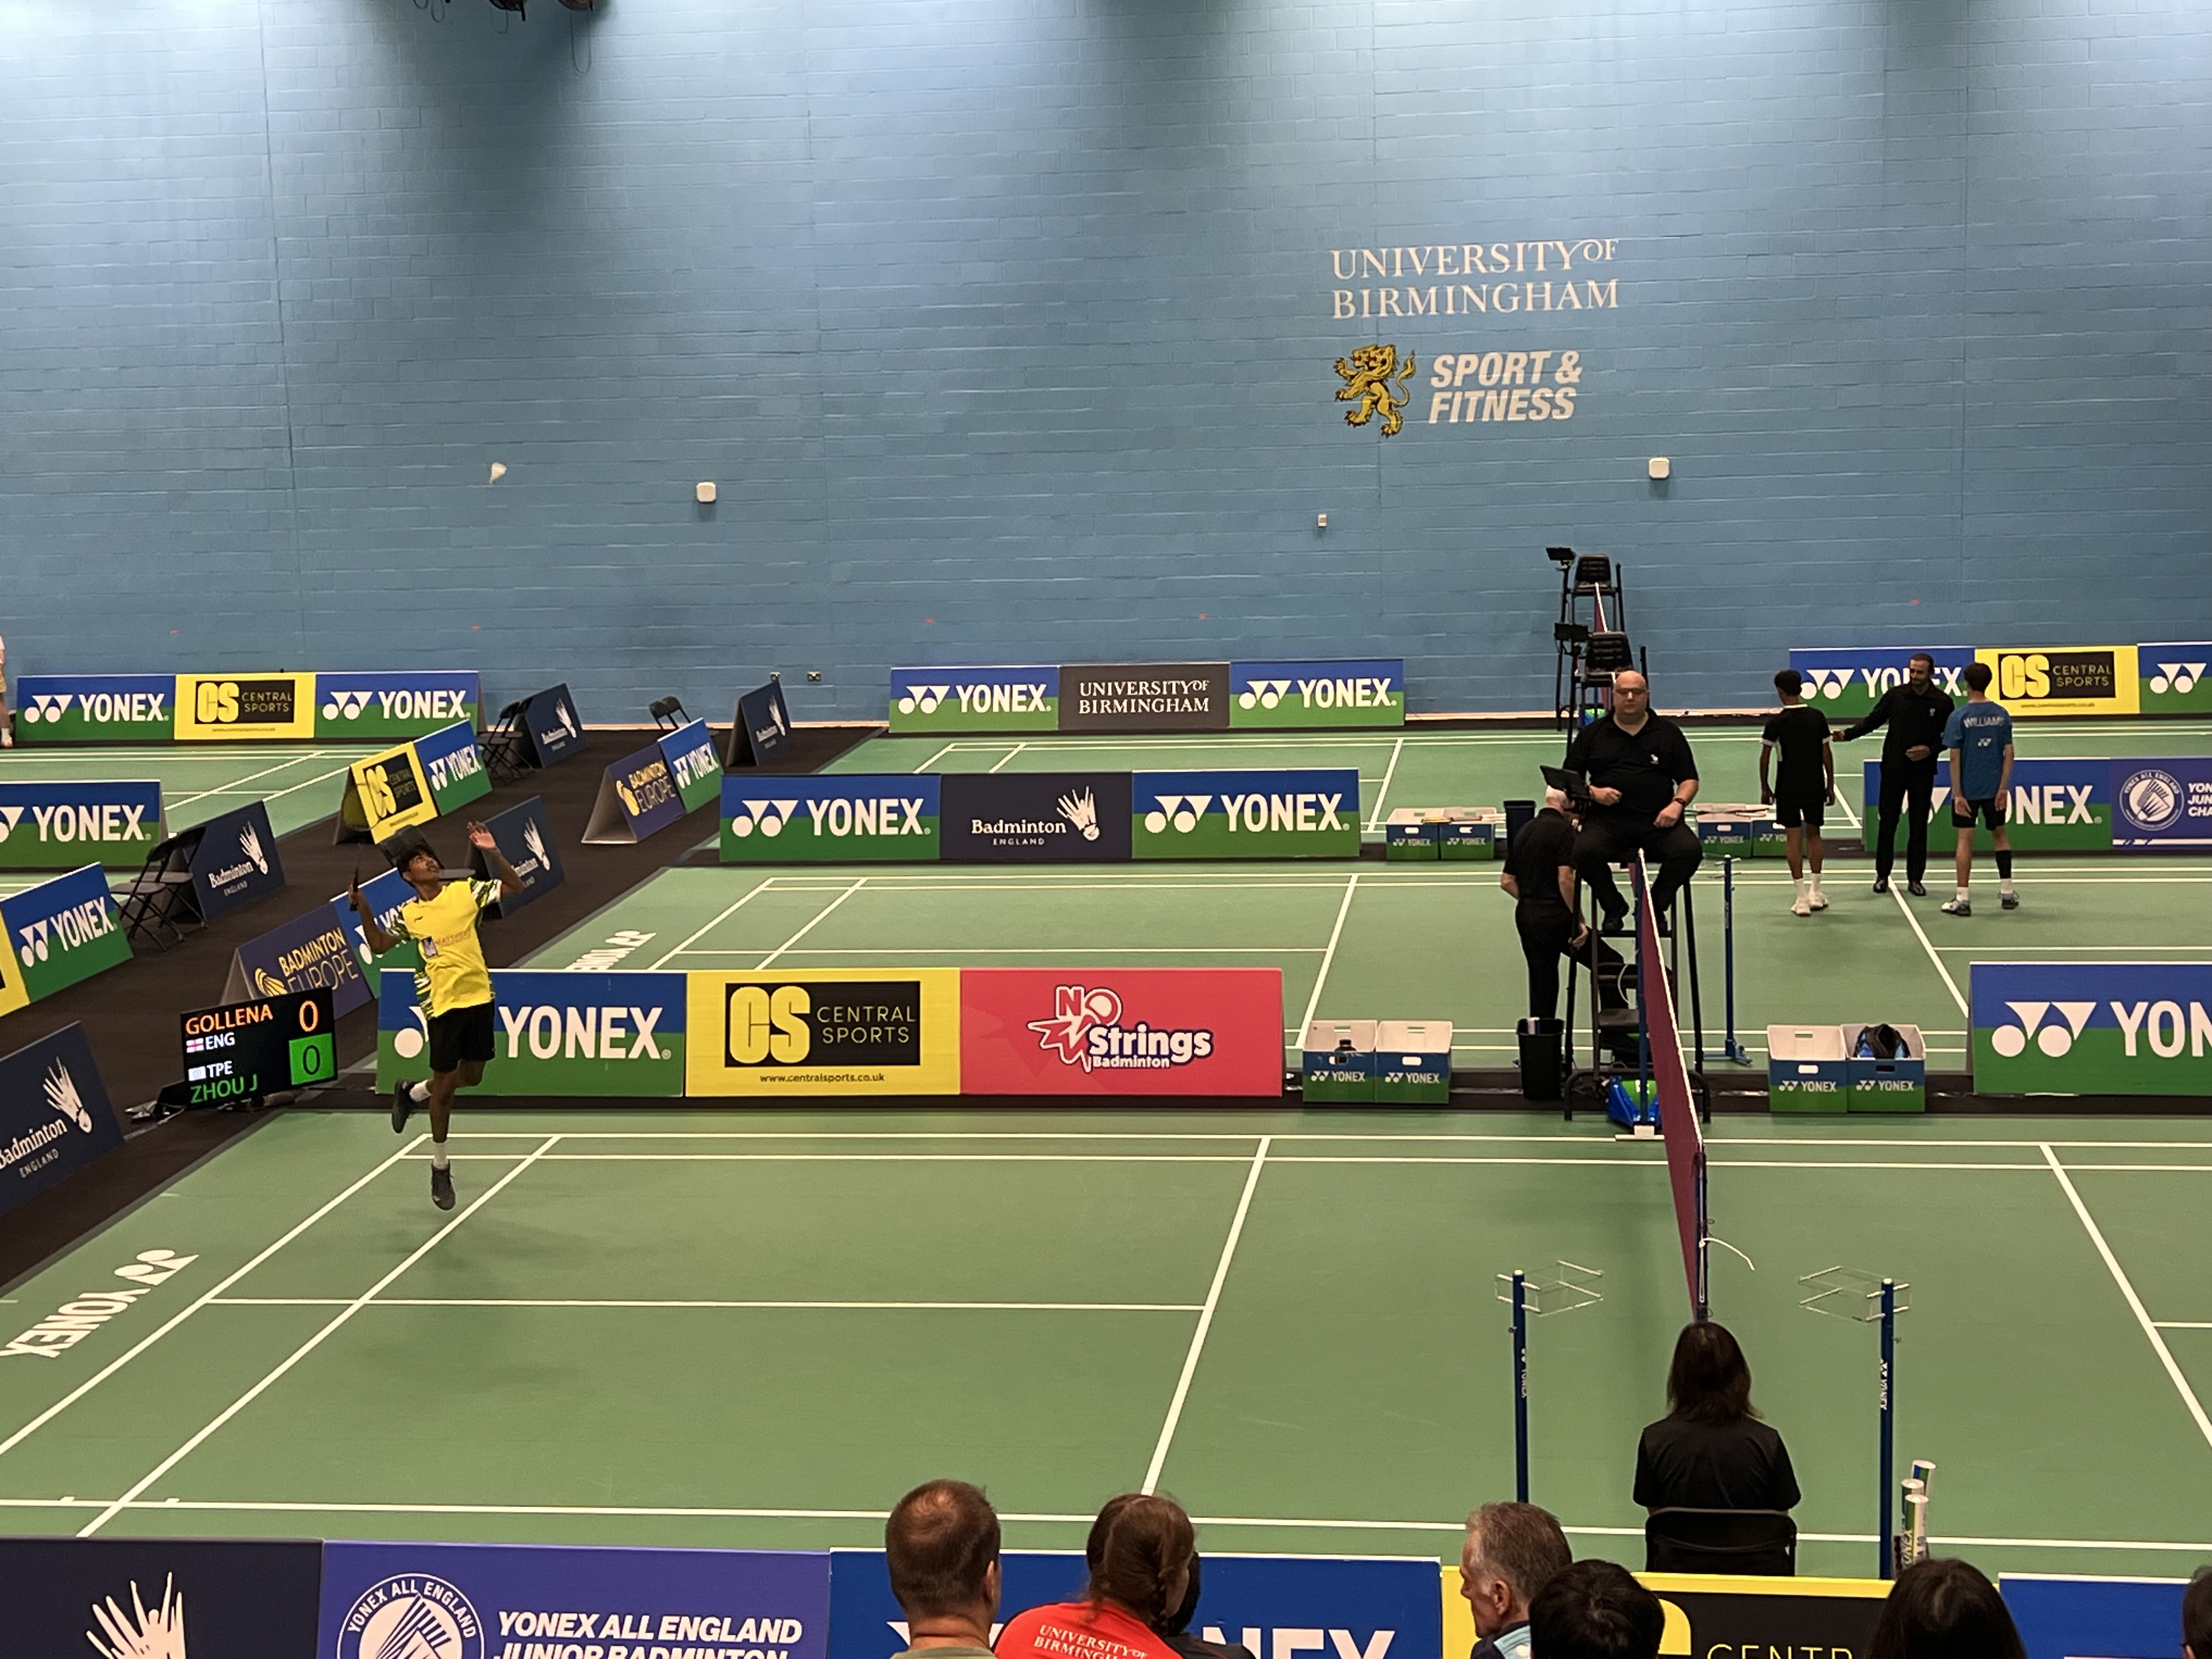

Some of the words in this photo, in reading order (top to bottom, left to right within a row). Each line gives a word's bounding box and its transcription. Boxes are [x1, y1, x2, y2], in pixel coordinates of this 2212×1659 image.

[1330, 240, 1583, 279] UNIVERSITY
[1583, 239, 1619, 261] OF
[1333, 278, 1619, 318] BIRMINGHAM
[1431, 349, 1551, 388] SPORT
[1555, 350, 1582, 383] &
[1429, 387, 1577, 424] FITNESS
[1861, 667, 1962, 698] YOX
[2001, 654, 2050, 698] CS
[2053, 664, 2112, 675] CENTRAL
[2056, 676, 2109, 687] SPORTS
[197, 682, 239, 723] CS
[241, 691, 292, 702] CENTRAL
[956, 684, 1047, 713] YONEX
[1080, 681, 1193, 697] UNIVERSITY
[1192, 680, 1210, 691] OF
[1297, 678, 1392, 708] YONEX
[78, 693, 165, 723] YONEX
[244, 703, 290, 713] SPORTS
[378, 690, 467, 719] YONEX
[1079, 697, 1210, 714] BIRMINGHAM
[445, 743, 482, 782] YONEX
[634, 775, 676, 813] EUROPE
[2005, 785, 2093, 825] NEX
[32, 804, 144, 842] YONEX
[806, 798, 924, 837] YONEX
[972, 819, 1066, 834] Badminton
[1220, 793, 1342, 833] YONEX
[208, 860, 254, 889] Badminton
[49, 896, 115, 952] YONEX
[278, 927, 347, 977] BADMINTON
[185, 1004, 274, 1035] GOLLENA
[299, 1000, 319, 1032] 0
[729, 985, 811, 1064] CS
[816, 1006, 916, 1023] CENTRAL
[205, 1031, 236, 1051] ENG
[498, 1005, 663, 1059] YONEX
[822, 1026, 910, 1043] SPORTS
[1089, 1024, 1212, 1063] Strings
[206, 1060, 233, 1078] TPE
[302, 1044, 321, 1076] 0
[1092, 1054, 1171, 1069] Badminton
[190, 1075, 245, 1104] ZHOU
[249, 1073, 258, 1092] J
[760, 1072, 885, 1083] www.centralsports.co.uk
[1332, 1071, 1365, 1082] YONEX
[1406, 1073, 1440, 1084] YONEX
[1801, 1081, 1836, 1092] YONEX
[1878, 1080, 1914, 1091] YONEX
[19, 1148, 59, 1178] ENGLAND
[0, 1287, 151, 1358] YONEX
[347, 1588, 388, 1633] YONEX
[391, 1579, 419, 1597] ALL
[424, 1581, 476, 1638] ENGLAND
[499, 1611, 599, 1639] YONEX
[599, 1615, 654, 1640] ALL
[659, 1616, 803, 1644] ENGLAND
[1039, 1624, 1131, 1657] UNIVERSITY
